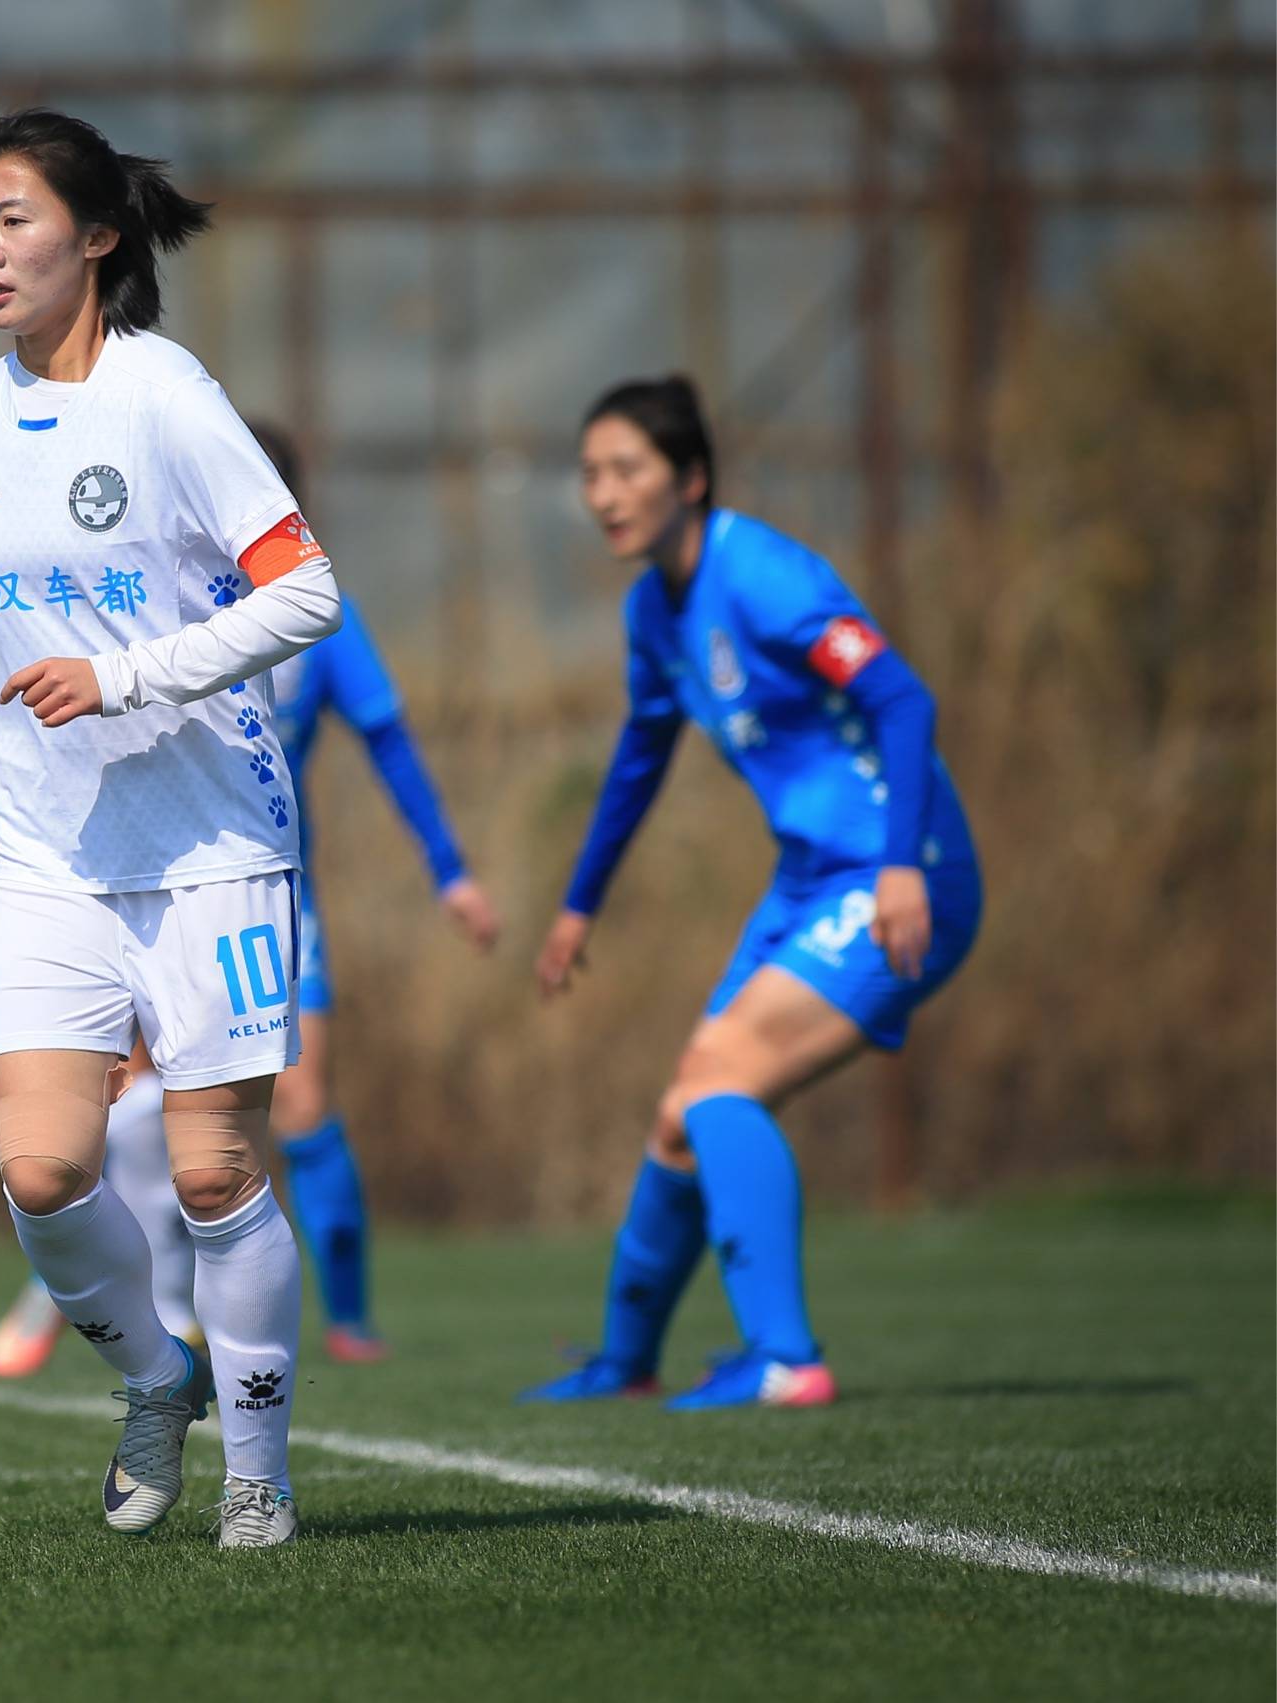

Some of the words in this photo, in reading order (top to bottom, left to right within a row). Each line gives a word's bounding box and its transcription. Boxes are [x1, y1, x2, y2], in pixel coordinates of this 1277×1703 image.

[216, 923, 288, 1016] 10
[228, 1015, 289, 1040] KELME
[235, 1394, 285, 1410] KELME
